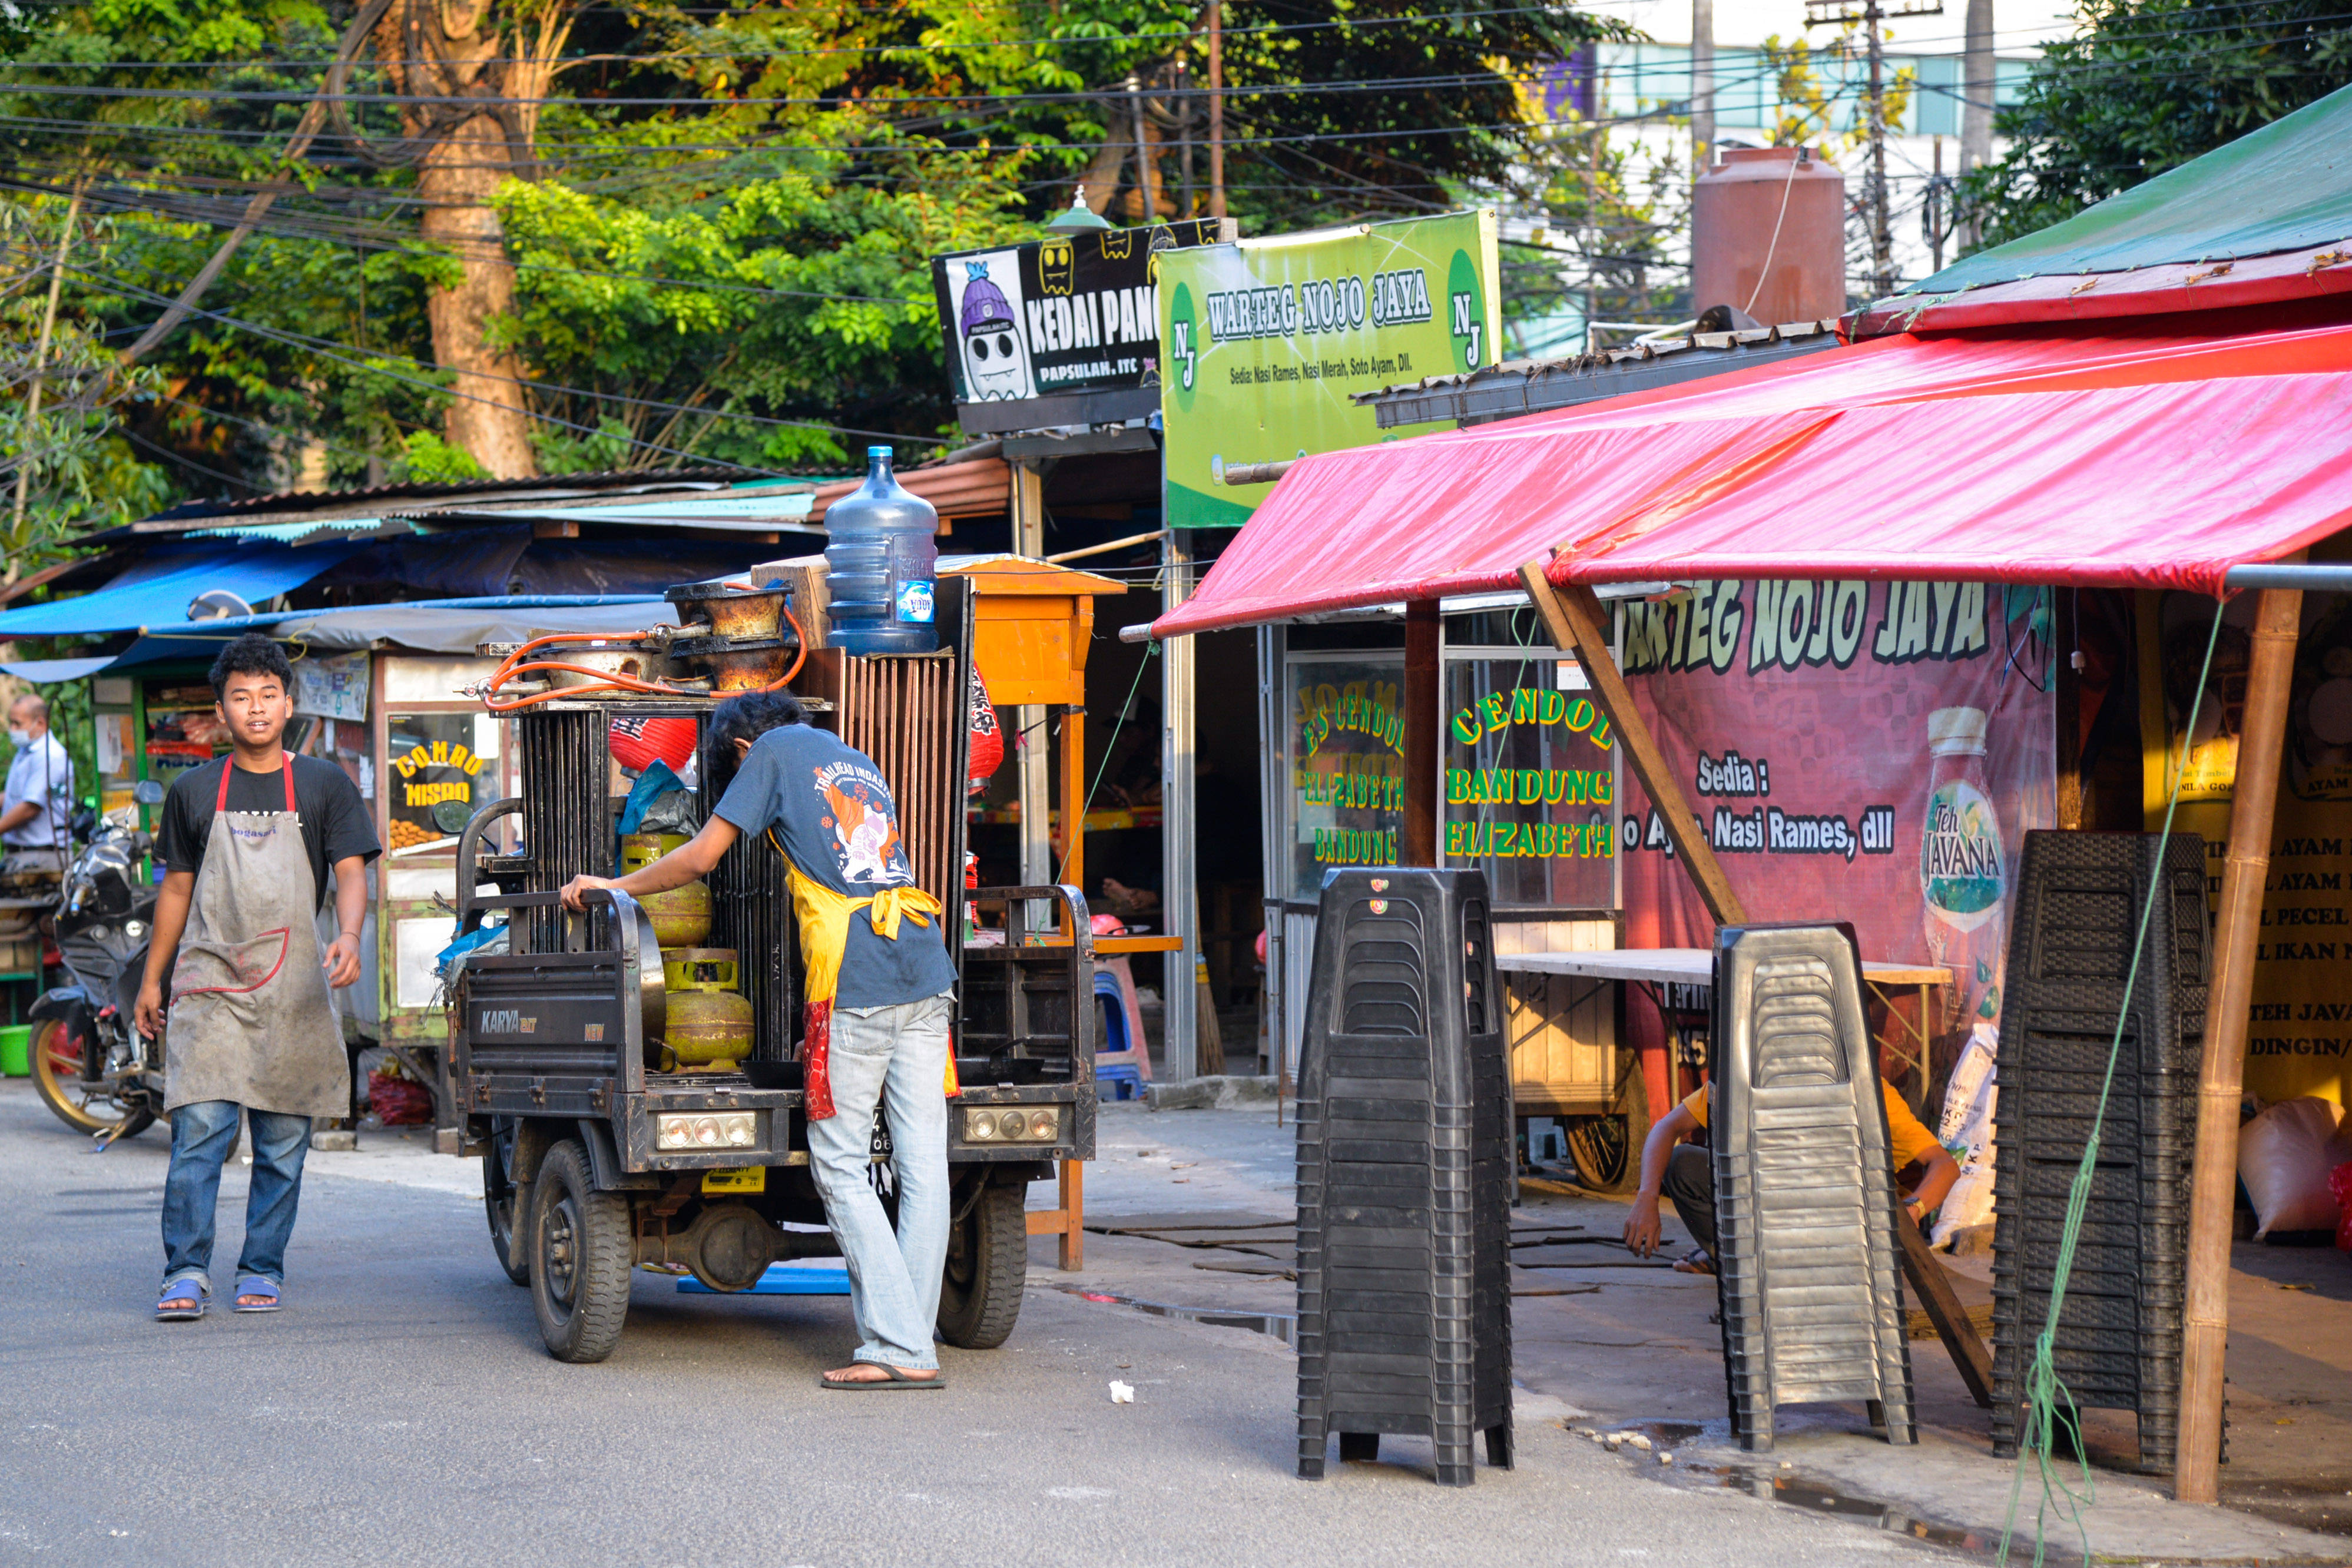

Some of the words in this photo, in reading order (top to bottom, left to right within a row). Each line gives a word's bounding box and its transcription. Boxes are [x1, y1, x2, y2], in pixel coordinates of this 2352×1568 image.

[1208, 284, 1296, 340] WARTEG
[1302, 274, 1365, 333] NOJO
[1372, 268, 1432, 327] JAYA
[1026, 292, 1100, 353] KEDAI
[1230, 367, 1253, 384] Sedia:
[1254, 365, 1271, 383] Nasi
[1273, 363, 1301, 383] Rames,
[1303, 360, 1320, 380] Nasi
[1321, 360, 1349, 380] Merah,
[1350, 357, 1369, 376] Soto
[1371, 356, 1397, 378] Ayam,
[1749, 579, 1867, 671] NOJO
[1874, 581, 1986, 661] JAYA
[1303, 705, 1329, 758] ES
[1452, 688, 1612, 751] CENDOL
[814, 761, 854, 792] TRAILHEAD
[1446, 768, 1612, 805] BANDUNG
[2308, 778, 2348, 793] AYAM
[406, 781, 470, 807] MISRO
[1304, 772, 1404, 812] ELIZABETH
[231, 826, 277, 838] bogasari
[1714, 811, 1763, 848] Nasi
[1769, 811, 1856, 857] Rames,
[1862, 810, 1892, 848] dll
[1935, 804, 1958, 833] Teh
[1314, 827, 1397, 865] BANDUNG
[1445, 820, 1614, 858] ELIZABETH
[2281, 838, 2343, 856] AYAM
[1925, 832, 2000, 887] JAVANA
[2278, 873, 2341, 891] AYAM
[2277, 907, 2349, 926] PECEL
[2275, 943, 2336, 960] IKAN
[481, 1010, 518, 1033] KARYA
[2250, 1003, 2291, 1021] TEH
[585, 1023, 604, 1042] NEW
